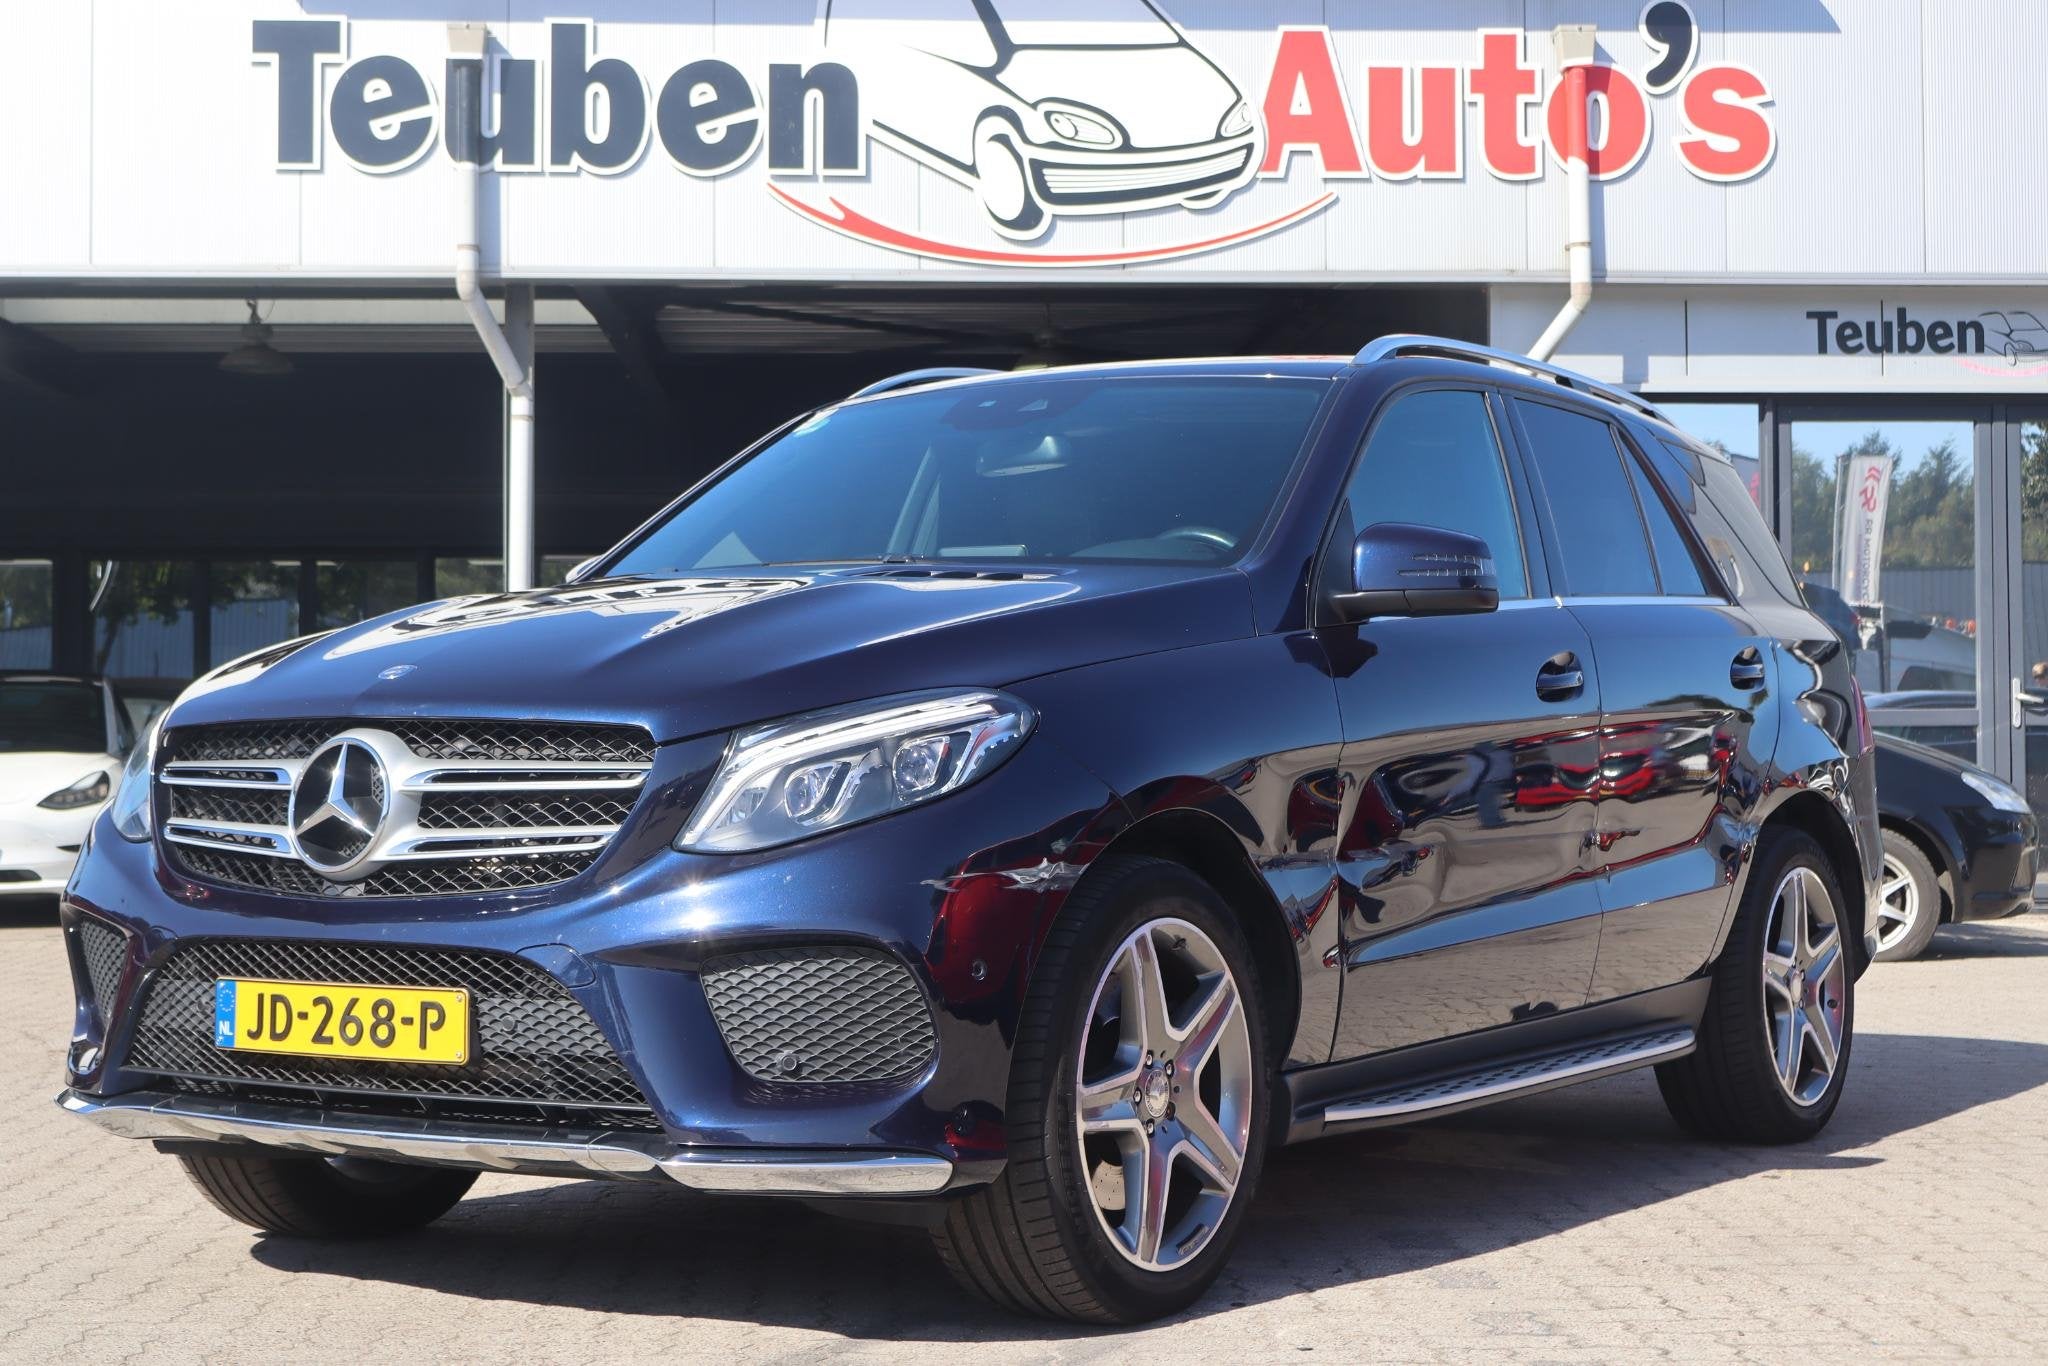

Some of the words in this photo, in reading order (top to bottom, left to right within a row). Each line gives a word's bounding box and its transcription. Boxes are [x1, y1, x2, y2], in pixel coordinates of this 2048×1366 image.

[251, 19, 861, 172] Teuben
[1261, 1, 1772, 176] Auto's
[1805, 307, 1985, 355] Teuben
[1862, 538, 1872, 604] MOTORCYC
[219, 1020, 234, 1036] NL
[247, 992, 446, 1050] JD-268-P
